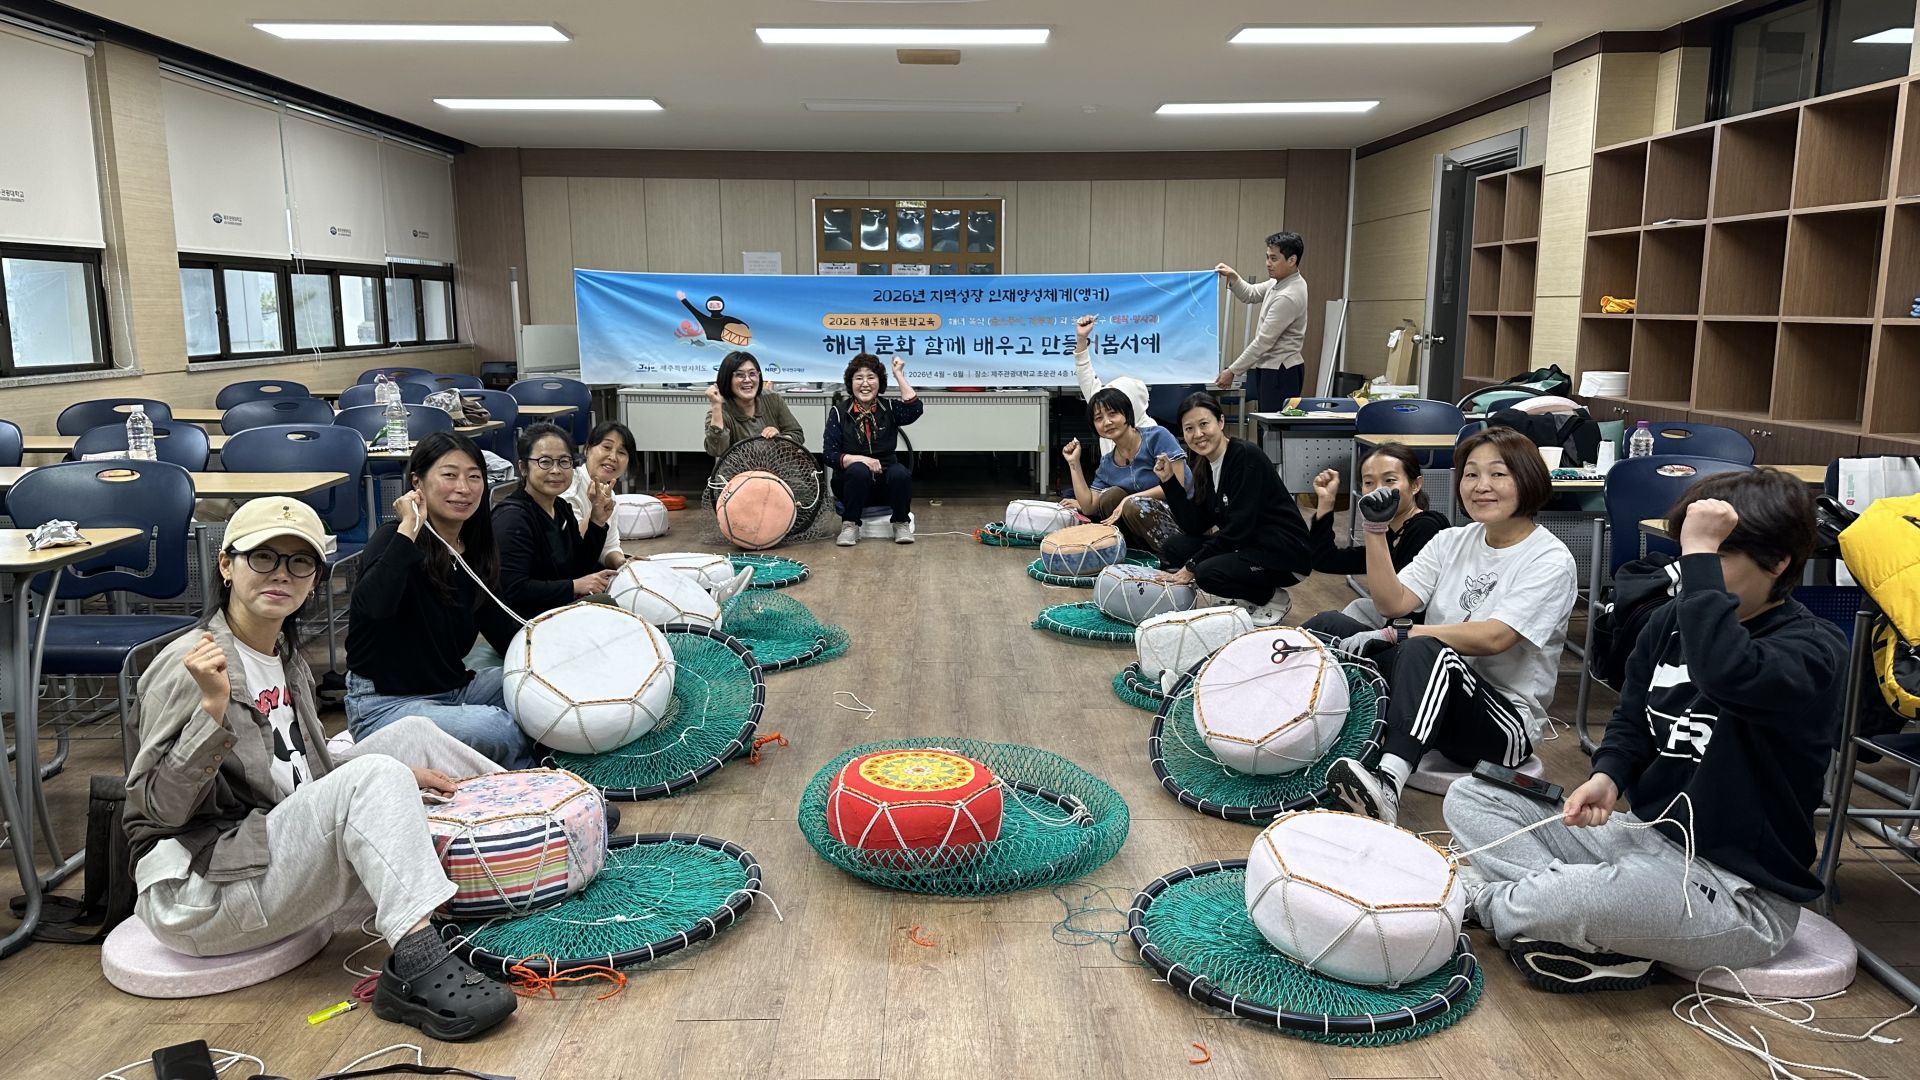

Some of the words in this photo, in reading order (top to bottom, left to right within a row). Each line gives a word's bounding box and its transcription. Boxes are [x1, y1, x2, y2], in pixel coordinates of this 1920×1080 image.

[873, 289, 925, 303] 2026년
[930, 288, 984, 303] 지역성장
[988, 287, 1110, 303] 인재양성체계(앵커)
[829, 317, 857, 326] 2026
[860, 317, 936, 327] 제주해녀문화교육
[822, 334, 866, 355] 해녀
[874, 335, 916, 356] 문화
[925, 335, 966, 356] 함께
[973, 335, 1034, 356] 배우고
[908, 370, 932, 378] 2026년
[934, 370, 945, 378] 4월
[952, 370, 964, 378] 6월
[991, 370, 1035, 378] 제주관광대학교
